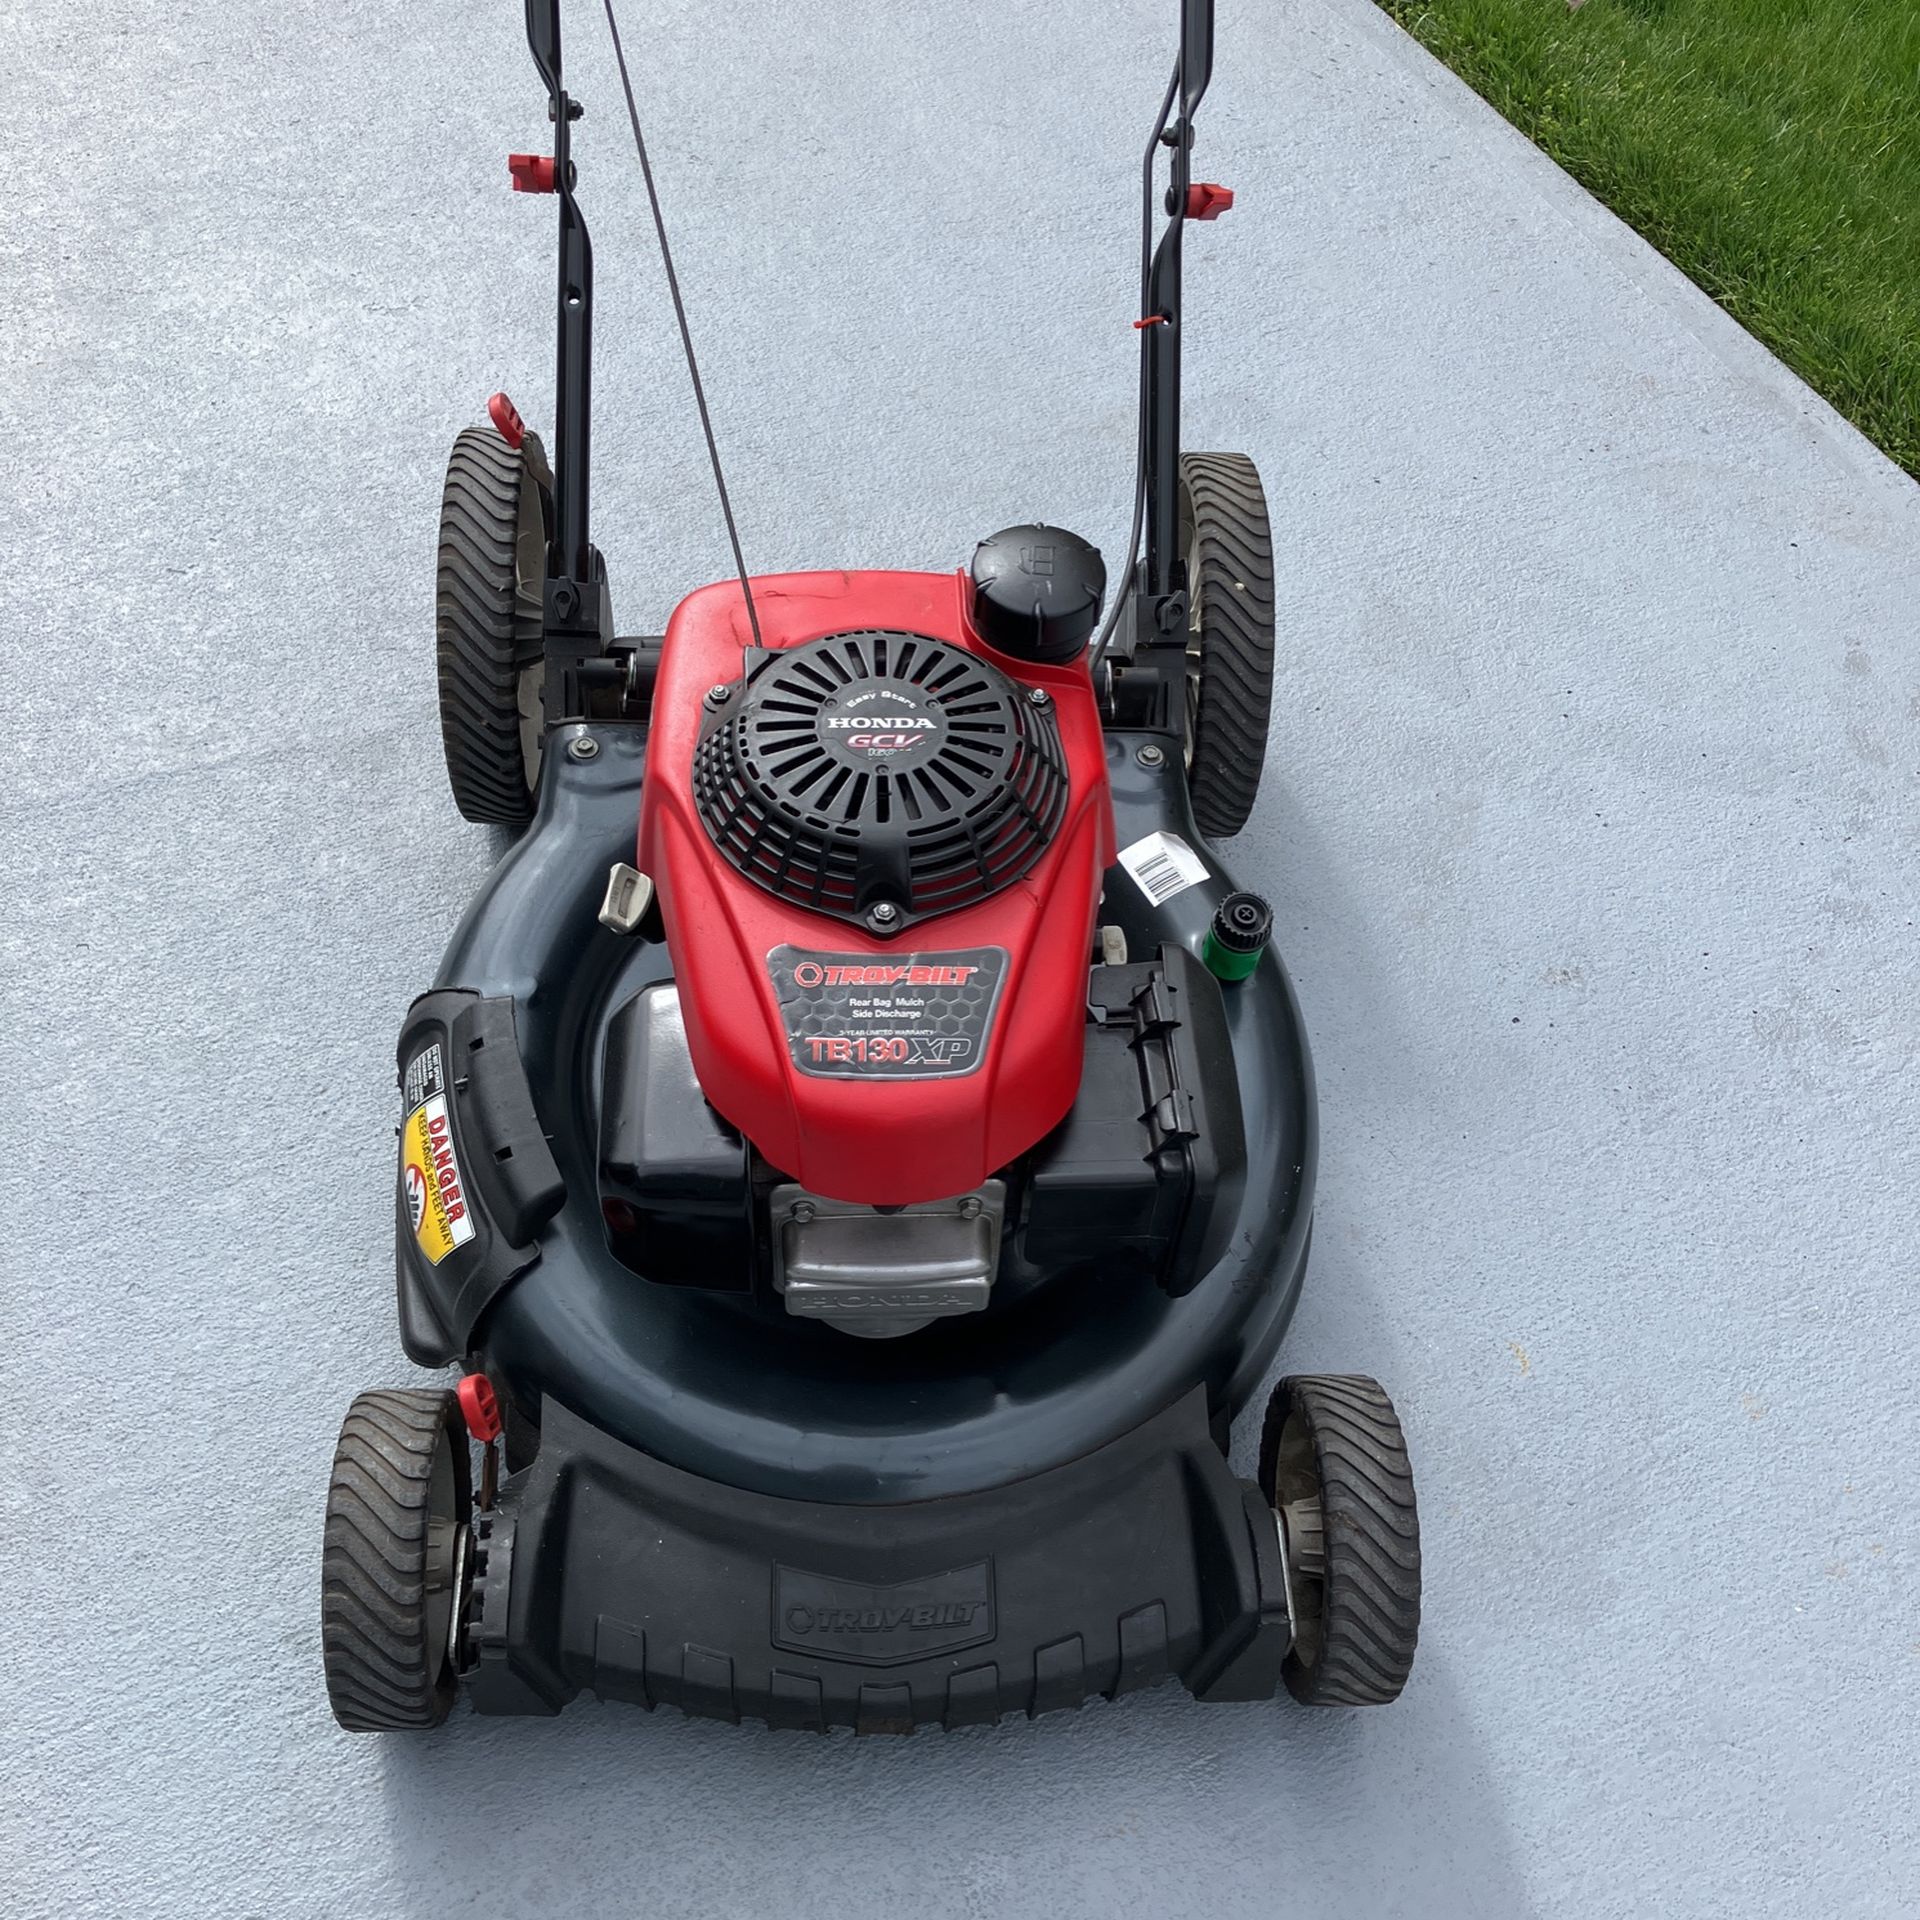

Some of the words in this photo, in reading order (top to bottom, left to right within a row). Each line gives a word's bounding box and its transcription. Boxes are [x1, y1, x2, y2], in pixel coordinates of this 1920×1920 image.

[827, 717, 937, 729] HONDA
[846, 733, 925, 748] GCV
[824, 965, 973, 987] TROY-BILT
[849, 998, 871, 1007] Rear
[873, 998, 891, 1009] Bag
[895, 997, 925, 1007] Mulch
[852, 1010, 873, 1019] Side
[875, 1010, 922, 1020] Discharge
[418, 1114, 428, 1137] KEEP
[421, 1138, 433, 1172] HANDS
[428, 1115, 465, 1224] DANGER
[426, 1173, 436, 1190] and
[430, 1190, 444, 1215] FEET
[437, 1217, 452, 1246] AWAY
[818, 1602, 979, 1633] TROY-BILT
